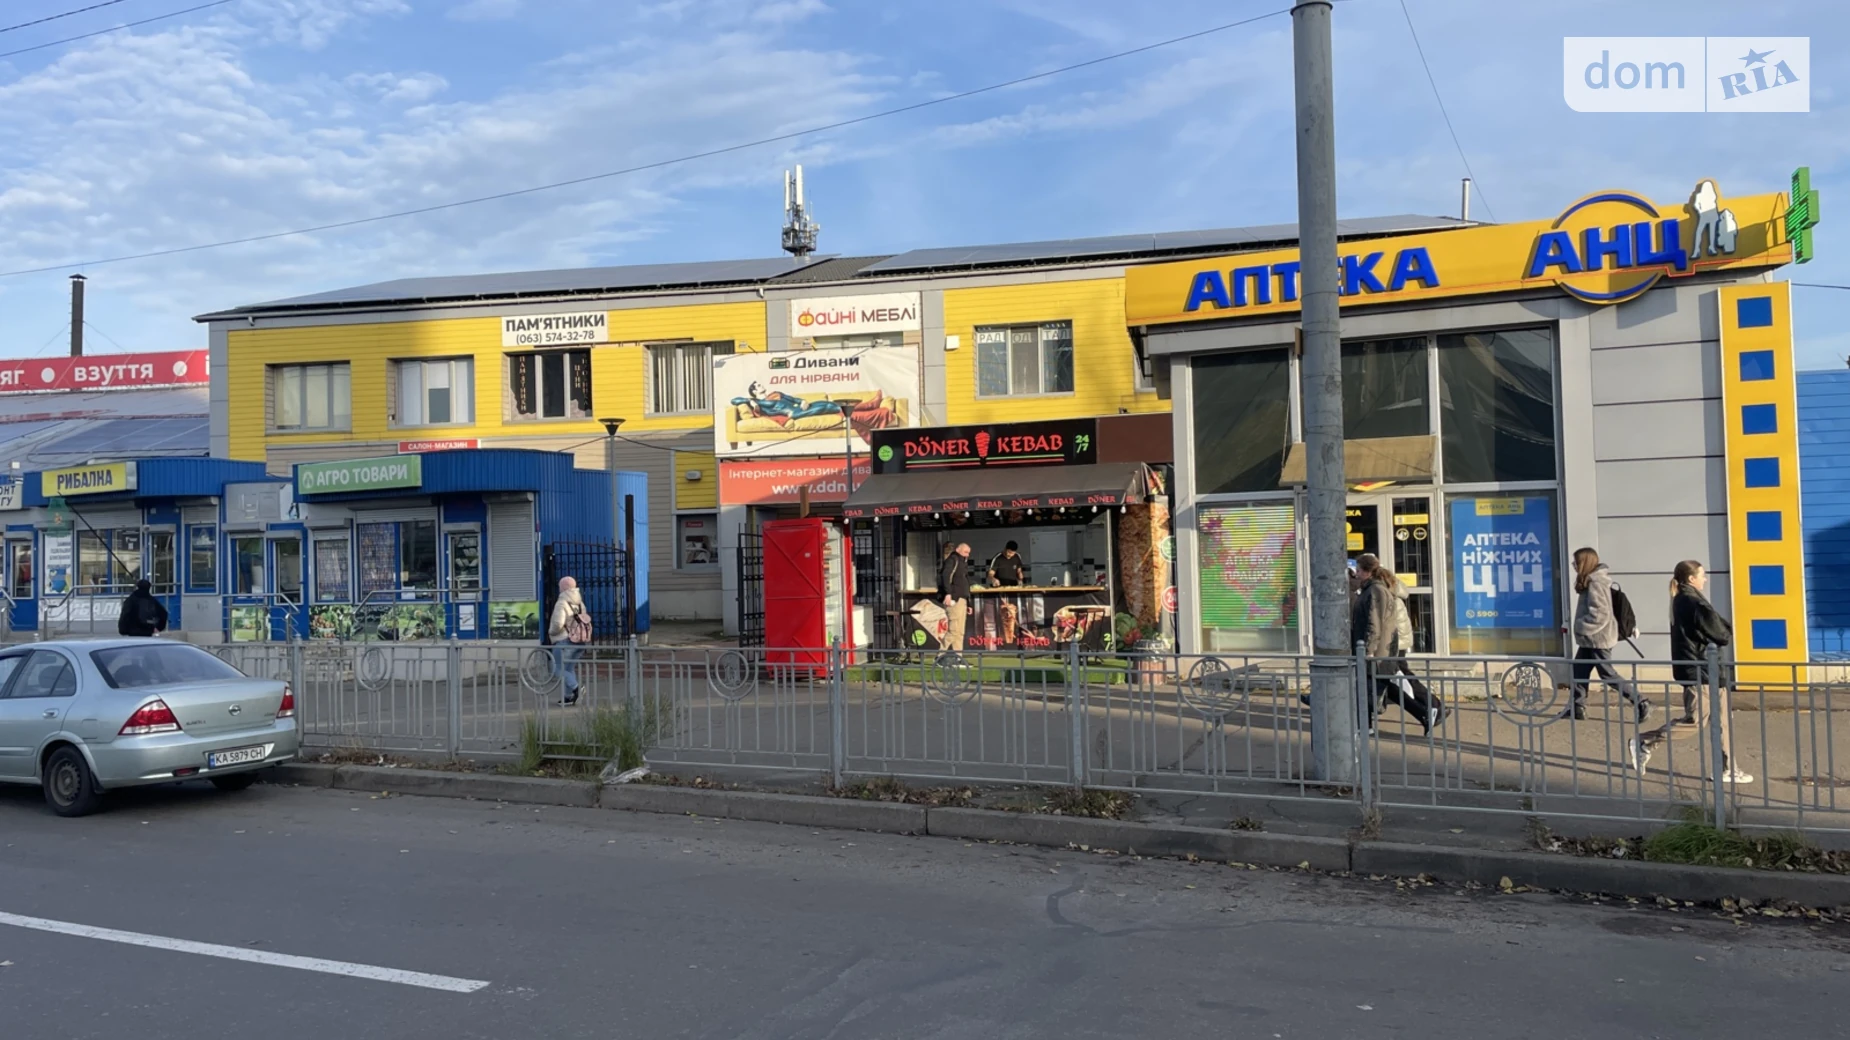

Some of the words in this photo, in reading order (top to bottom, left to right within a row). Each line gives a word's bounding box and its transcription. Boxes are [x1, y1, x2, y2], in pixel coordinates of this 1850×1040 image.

[1528, 218, 1687, 278] АНЦ
[1183, 247, 1440, 312] АПТКА
[505, 314, 605, 332] ПАМ'ЯТНИКИ
[516, 332, 543, 345] (063)
[545, 330, 595, 343] 574-32-78
[793, 356, 860, 369] Дивани
[74, 363, 154, 385] взуття
[407, 442, 468, 451] САЛОН-МАГАЗИН
[904, 436, 971, 458] DÖNER
[997, 435, 1063, 453] KEBAB
[1075, 434, 1090, 443] 24
[316, 469, 350, 486] АГРО
[352, 464, 408, 484] ТОВАРИ
[729, 467, 838, 480] Інтернет-магазин
[874, 506, 899, 515] DÖNER
[908, 505, 933, 513] KEBAB
[942, 501, 969, 510] DÖNER
[977, 500, 1003, 508] KEBAB
[1011, 498, 1038, 507] DÖNER
[1048, 497, 1075, 505] KEBAB
[1087, 494, 1115, 503] DÖNER
[1463, 532, 1540, 547] АПТЕКА
[1463, 564, 1544, 598] ЦІН
[229, 752, 249, 762] 5879
